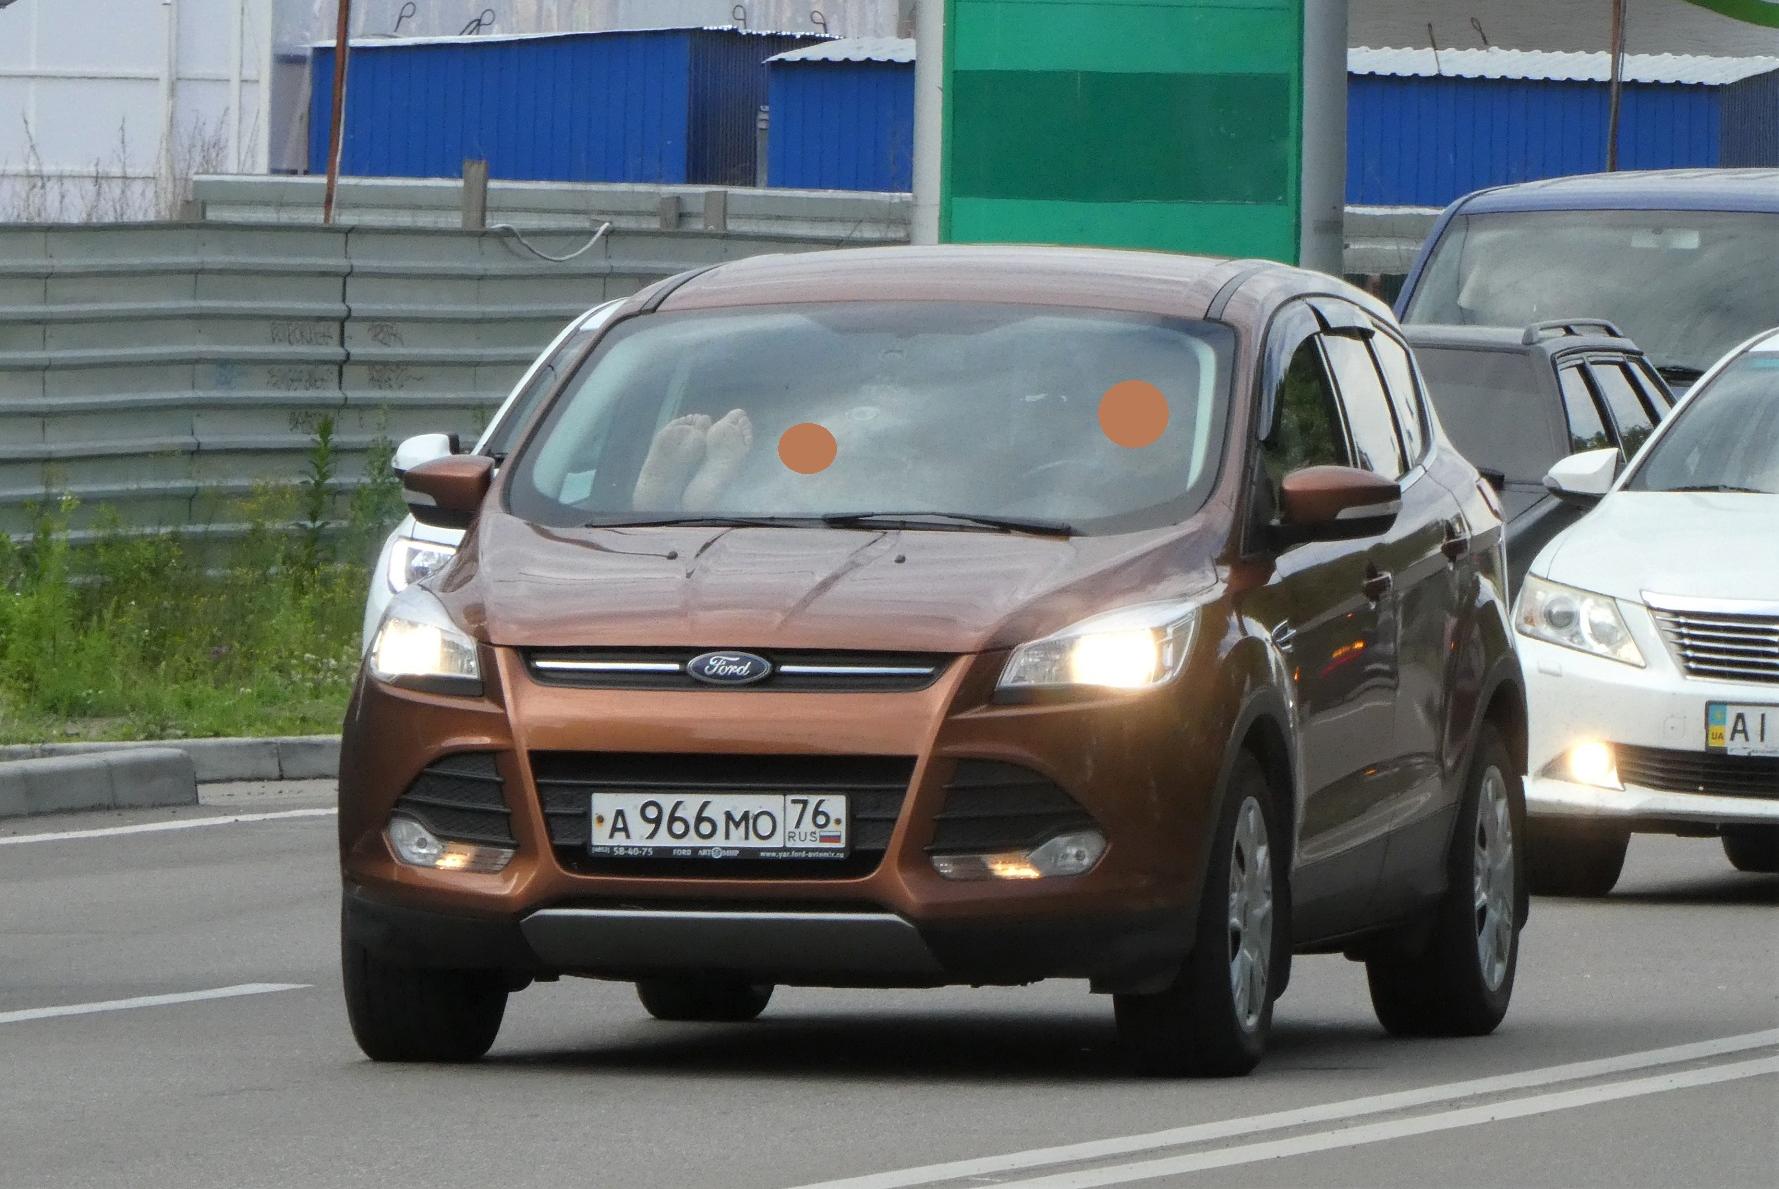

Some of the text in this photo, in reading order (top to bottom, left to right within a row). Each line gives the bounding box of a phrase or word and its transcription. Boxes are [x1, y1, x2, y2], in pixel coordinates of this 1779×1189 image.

[704, 655, 752, 676] Ford
[1711, 732, 1725, 741] UA
[790, 799, 831, 829] 76
[787, 831, 818, 842] RUS
[672, 848, 692, 856] FORD
